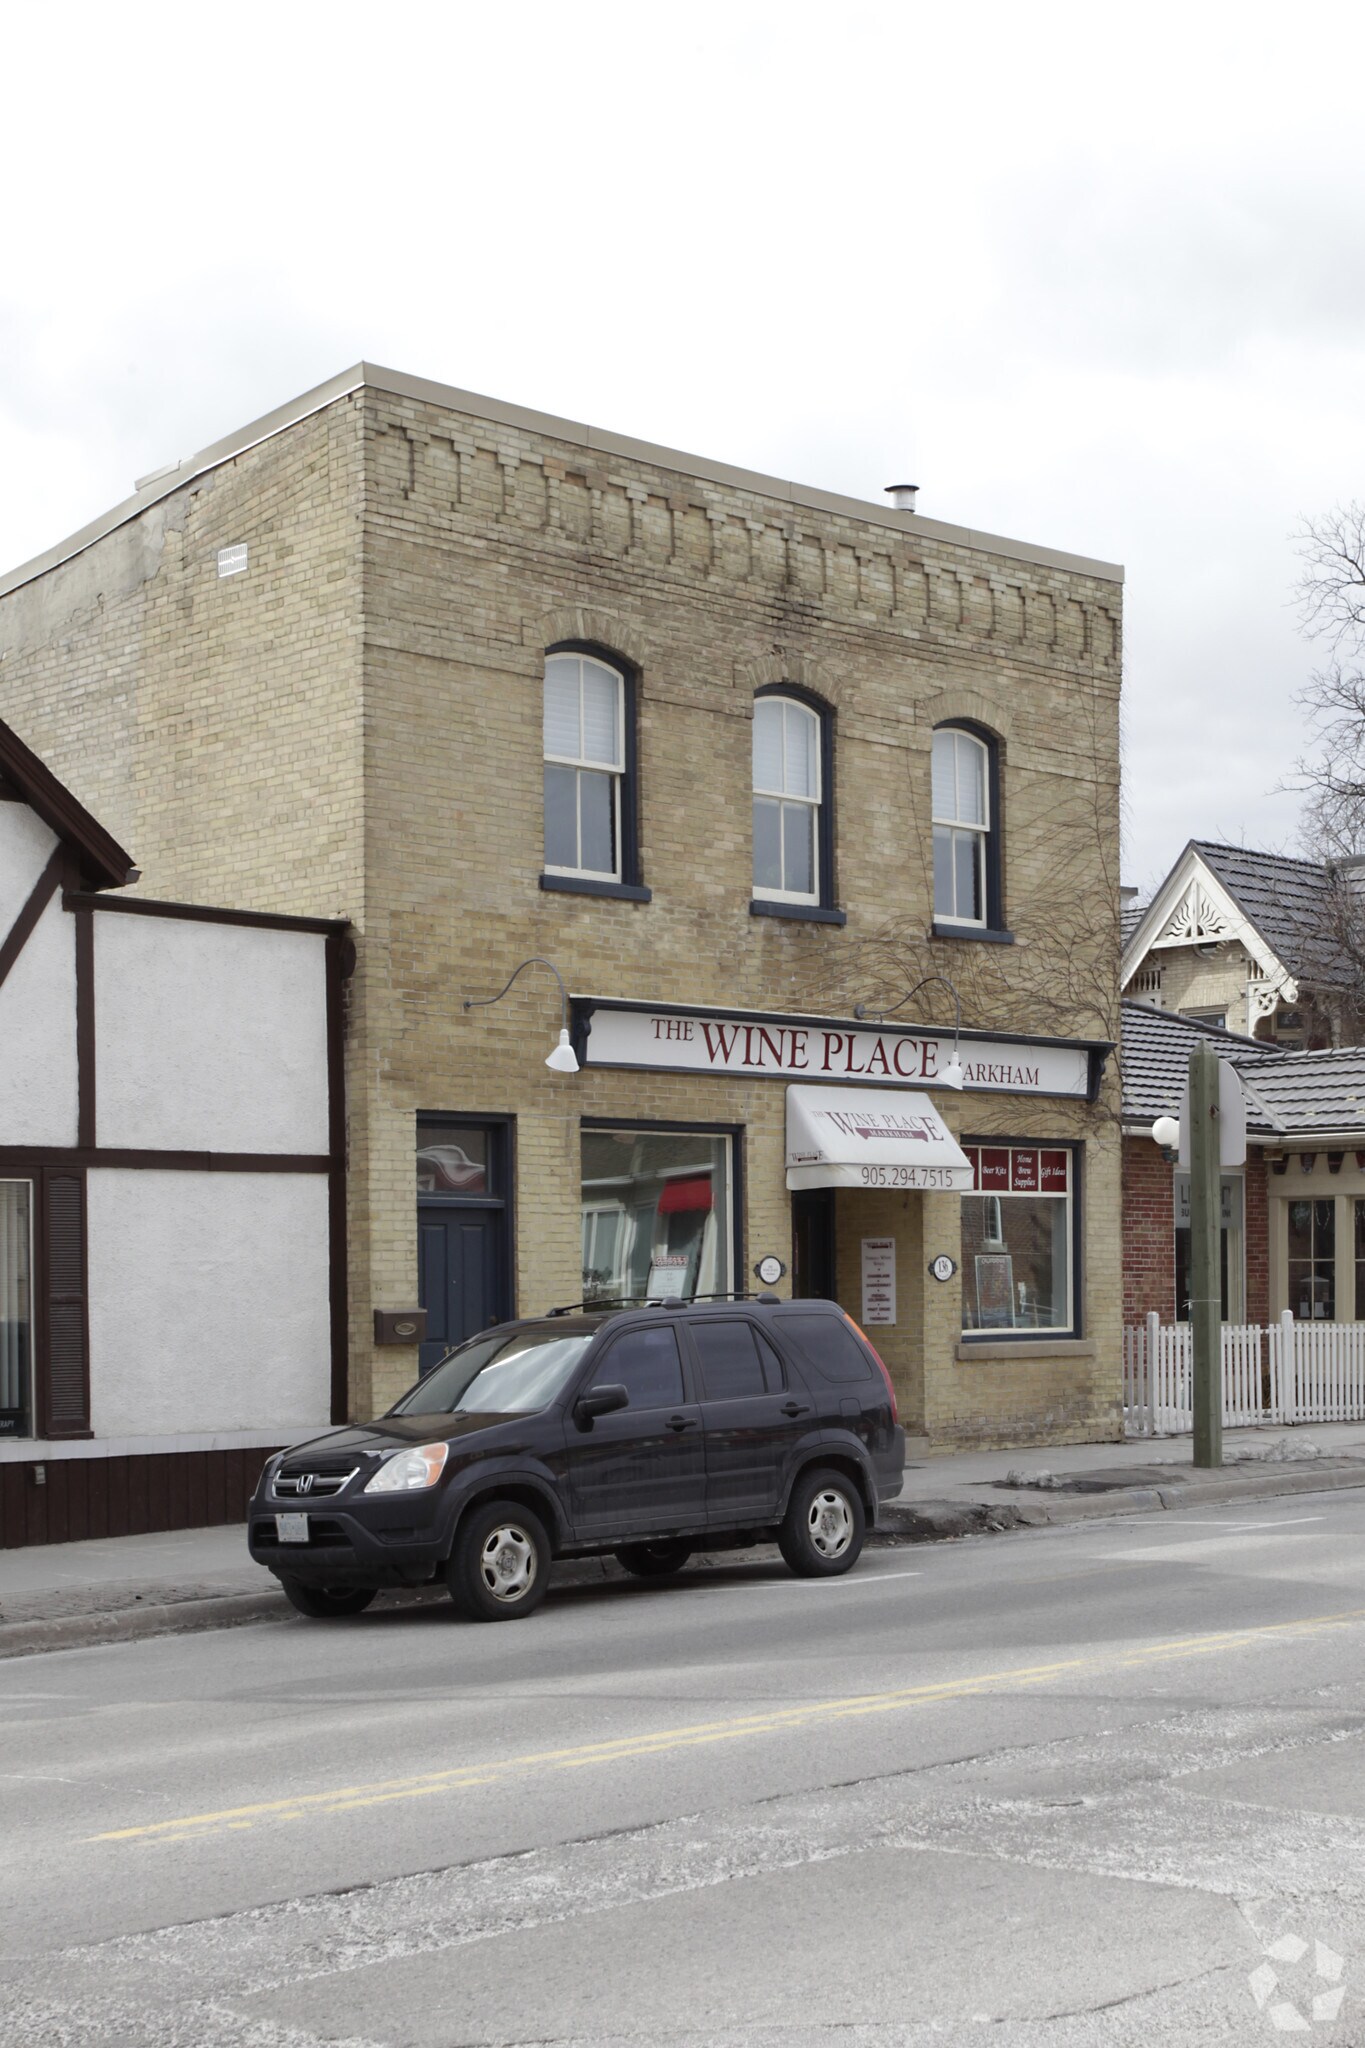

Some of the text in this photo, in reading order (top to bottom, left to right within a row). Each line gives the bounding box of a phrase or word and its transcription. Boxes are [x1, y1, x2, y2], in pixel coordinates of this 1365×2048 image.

[651, 1018, 939, 1079] THE WINE PLACE
[824, 1111, 880, 1136] WINE
[881, 1113, 944, 1141] PLACE
[869, 1129, 914, 1139] MARKHAM
[1017, 1154, 1032, 1163] Home
[983, 1166, 994, 1174] Beer
[1041, 1167, 1066, 1178] Gift Ideas
[861, 1166, 953, 1187] 905.294.7515
[1013, 1177, 1036, 1188] Supplies
